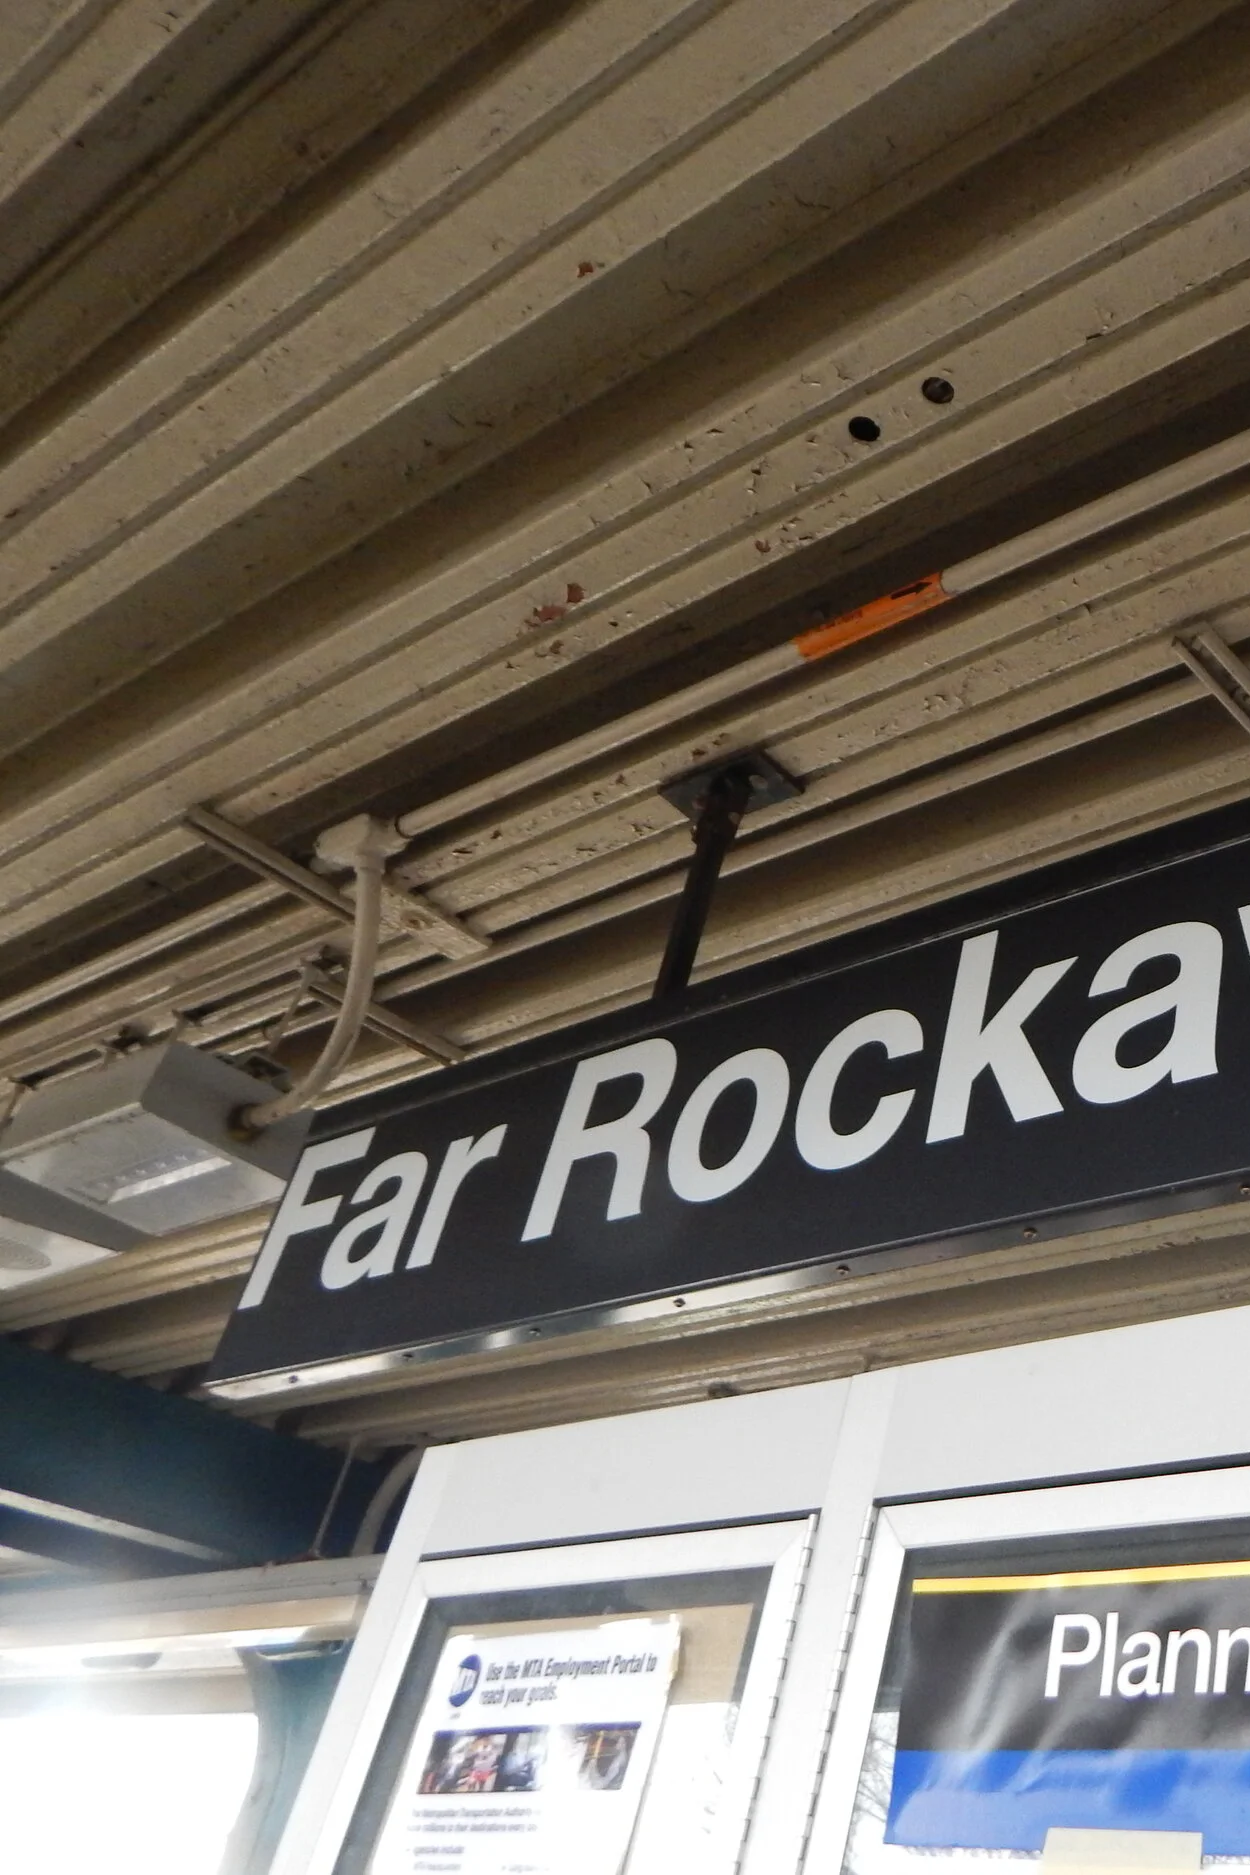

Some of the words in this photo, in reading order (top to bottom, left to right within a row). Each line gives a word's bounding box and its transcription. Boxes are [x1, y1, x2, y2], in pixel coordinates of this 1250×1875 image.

[238, 1123, 508, 1310] Far
[521, 1659, 544, 1679] MTA
[544, 1656, 611, 1680] Employment
[610, 1654, 646, 1674] Portal
[646, 1653, 658, 1672] to
